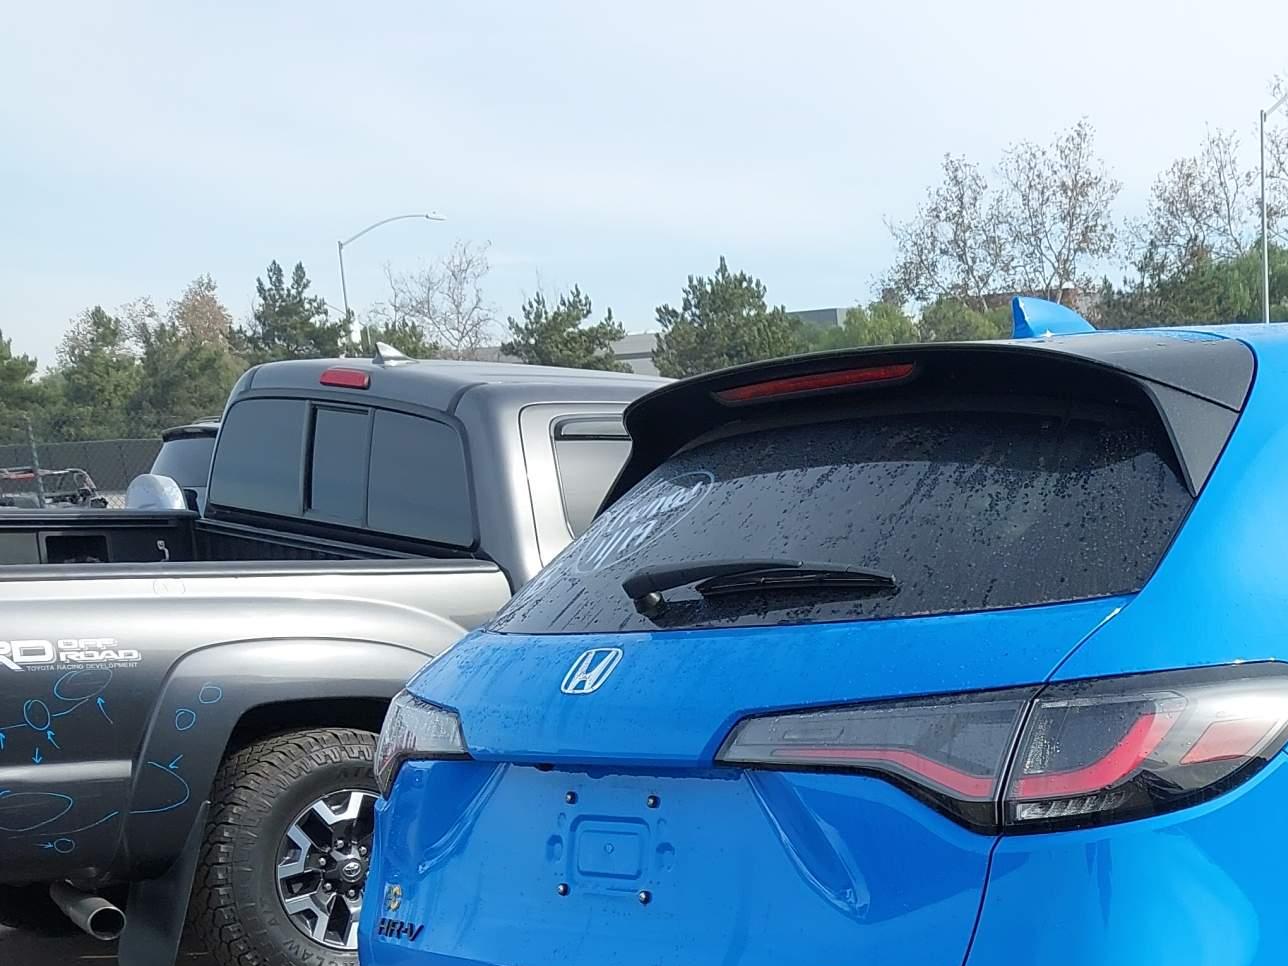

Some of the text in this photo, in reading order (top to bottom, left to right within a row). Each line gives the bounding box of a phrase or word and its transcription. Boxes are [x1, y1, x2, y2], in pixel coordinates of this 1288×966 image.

[57, 638, 118, 650] OFF
[0, 639, 56, 672] RD
[59, 649, 142, 664] ROAD
[26, 661, 138, 673] TOYOTA RACING DEVELOPMENT
[378, 917, 425, 942] HR-V
